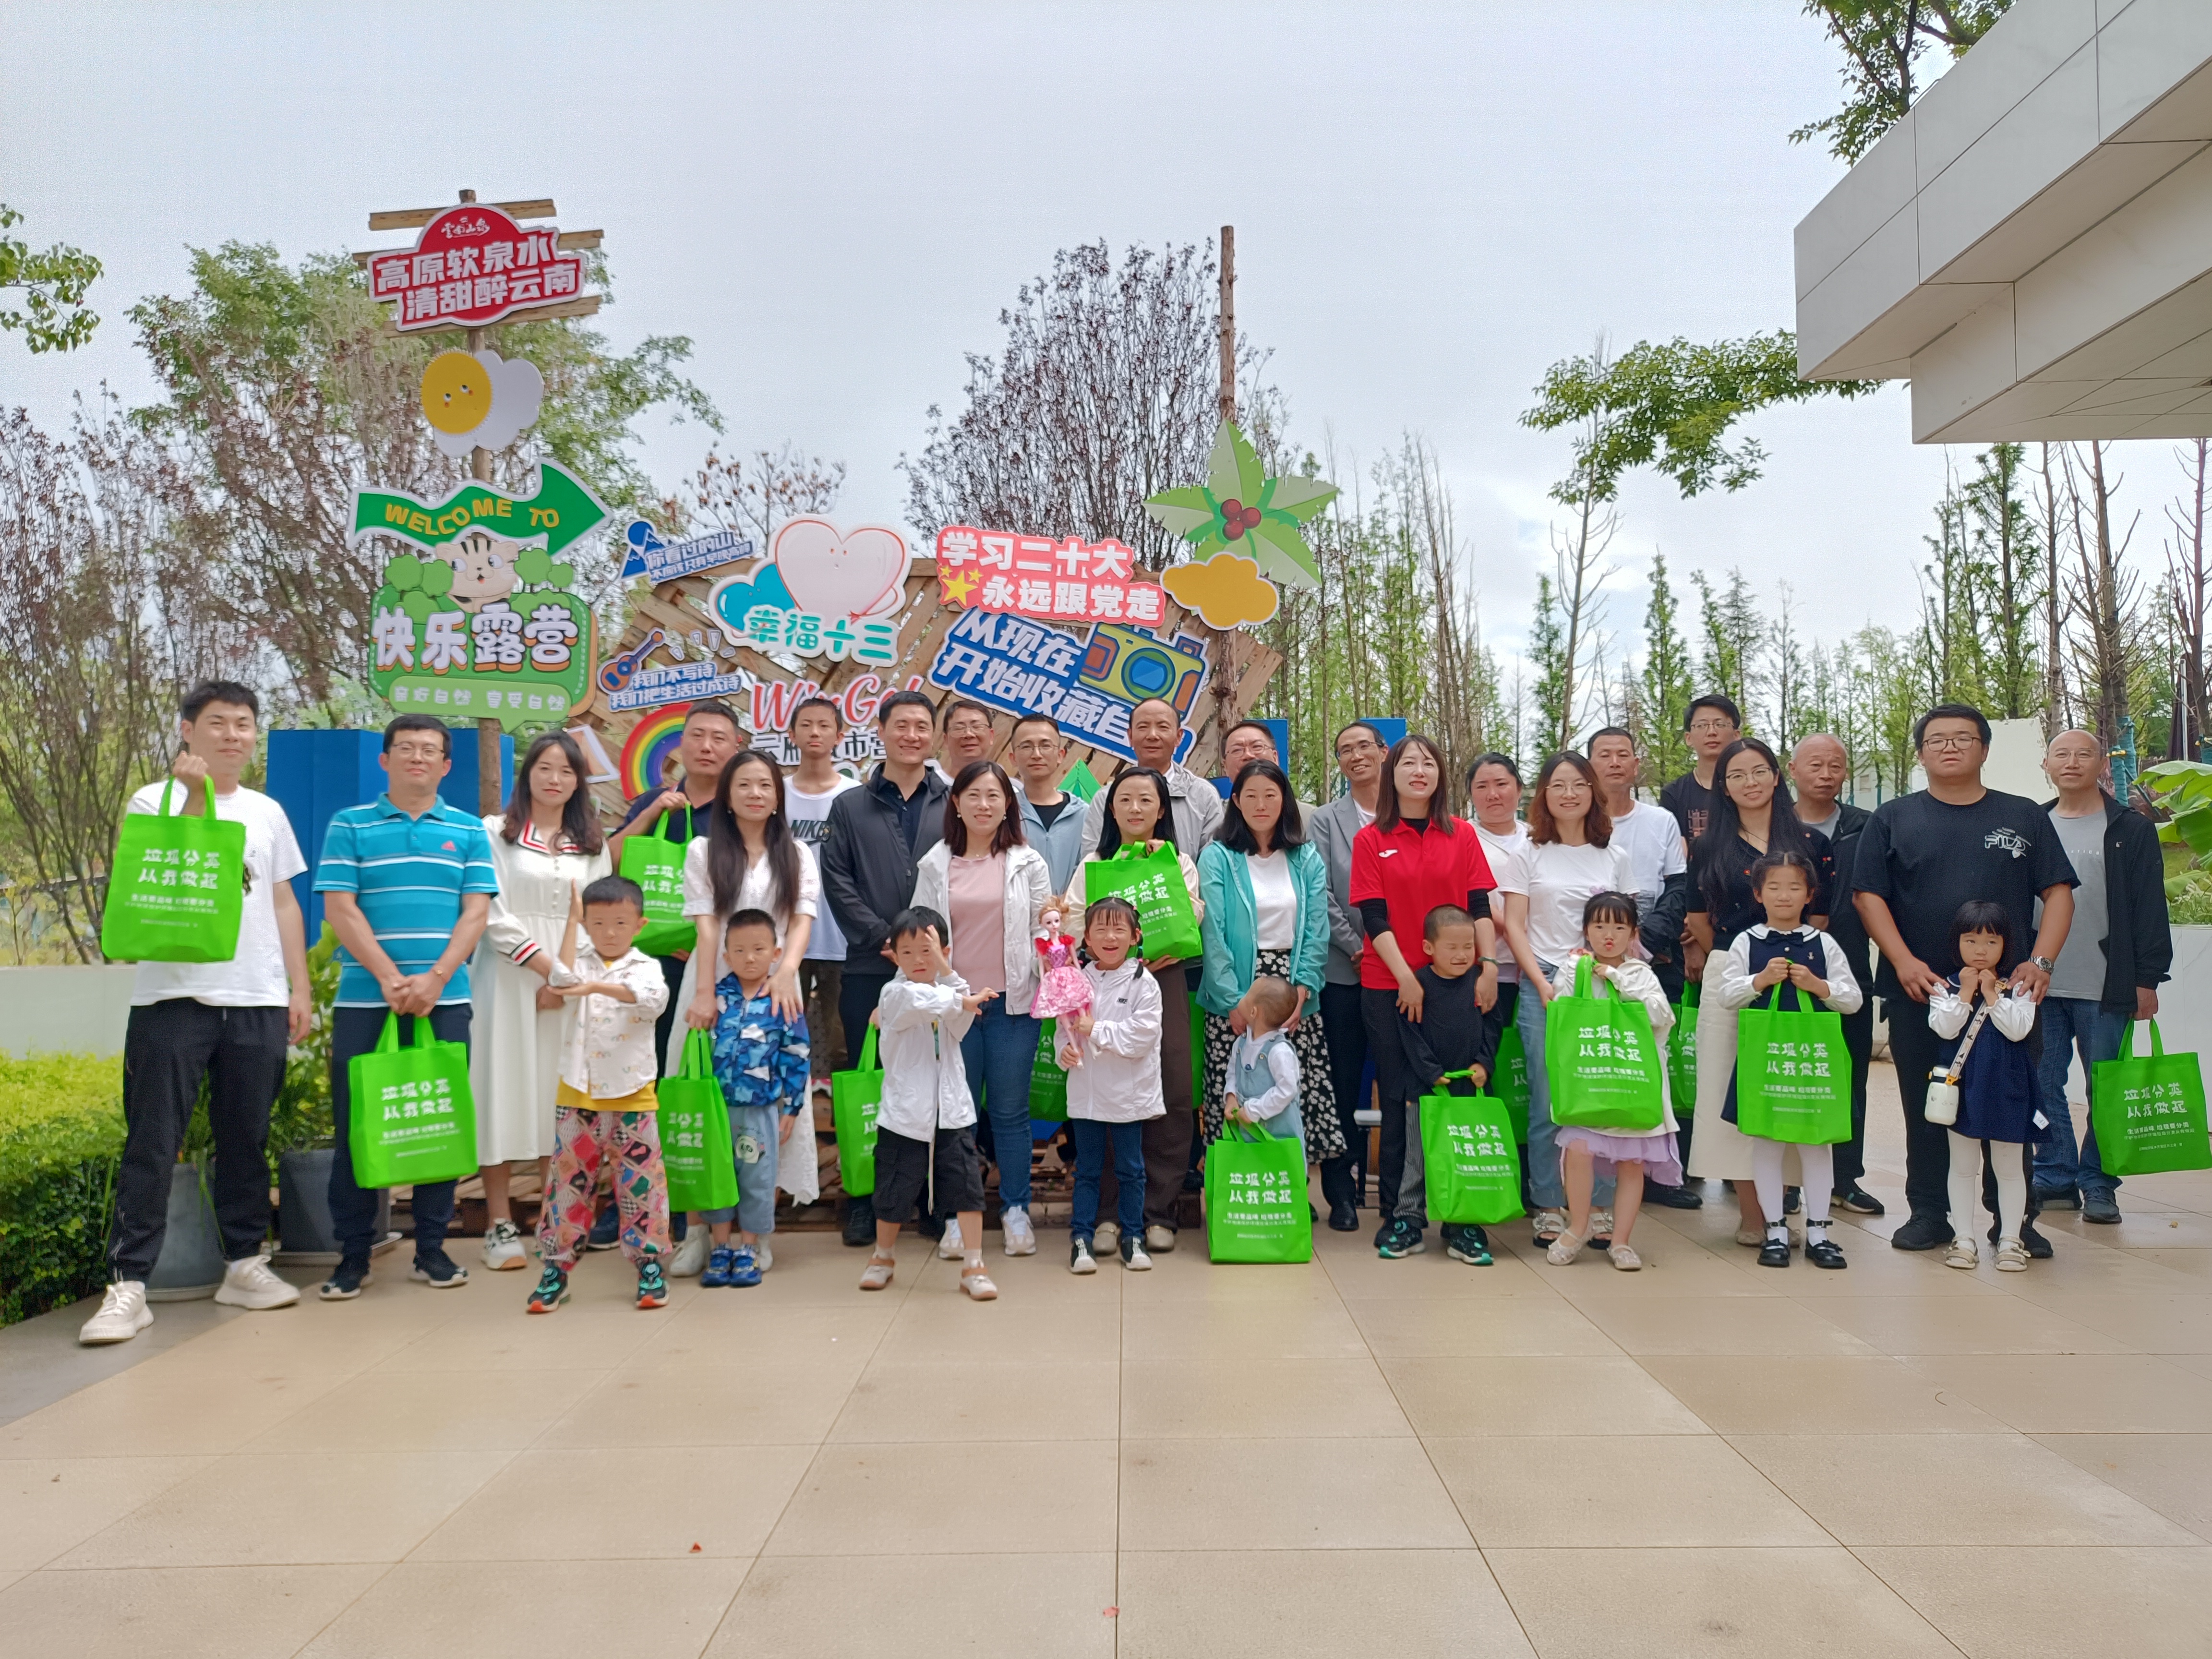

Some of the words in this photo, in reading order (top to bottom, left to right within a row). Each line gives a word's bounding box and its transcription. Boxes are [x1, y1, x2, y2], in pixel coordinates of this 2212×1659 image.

[376, 235, 551, 293] 高原软泉水
[406, 263, 576, 320] 清甜醉云南
[385, 498, 512, 535] WELCOME
[529, 508, 560, 528] TO
[648, 532, 734, 569] 你看过的山
[941, 531, 1130, 578] 学习二十大
[982, 575, 1161, 621] 永远跟党走
[371, 602, 578, 673] 快乐露营
[748, 609, 894, 660] 幸福十三
[954, 611, 1082, 678] 从现在
[610, 675, 740, 708] 我们把生活过成诗
[633, 663, 714, 689] 我们不写诗
[938, 642, 1186, 754] 开始收藏自
[2124, 1082, 2183, 1101] 垃圾分类
[2127, 1100, 2188, 1119] 从我做起
[1229, 1170, 1291, 1187] 垃圾分类
[1229, 1189, 1292, 1205] 从我做起
